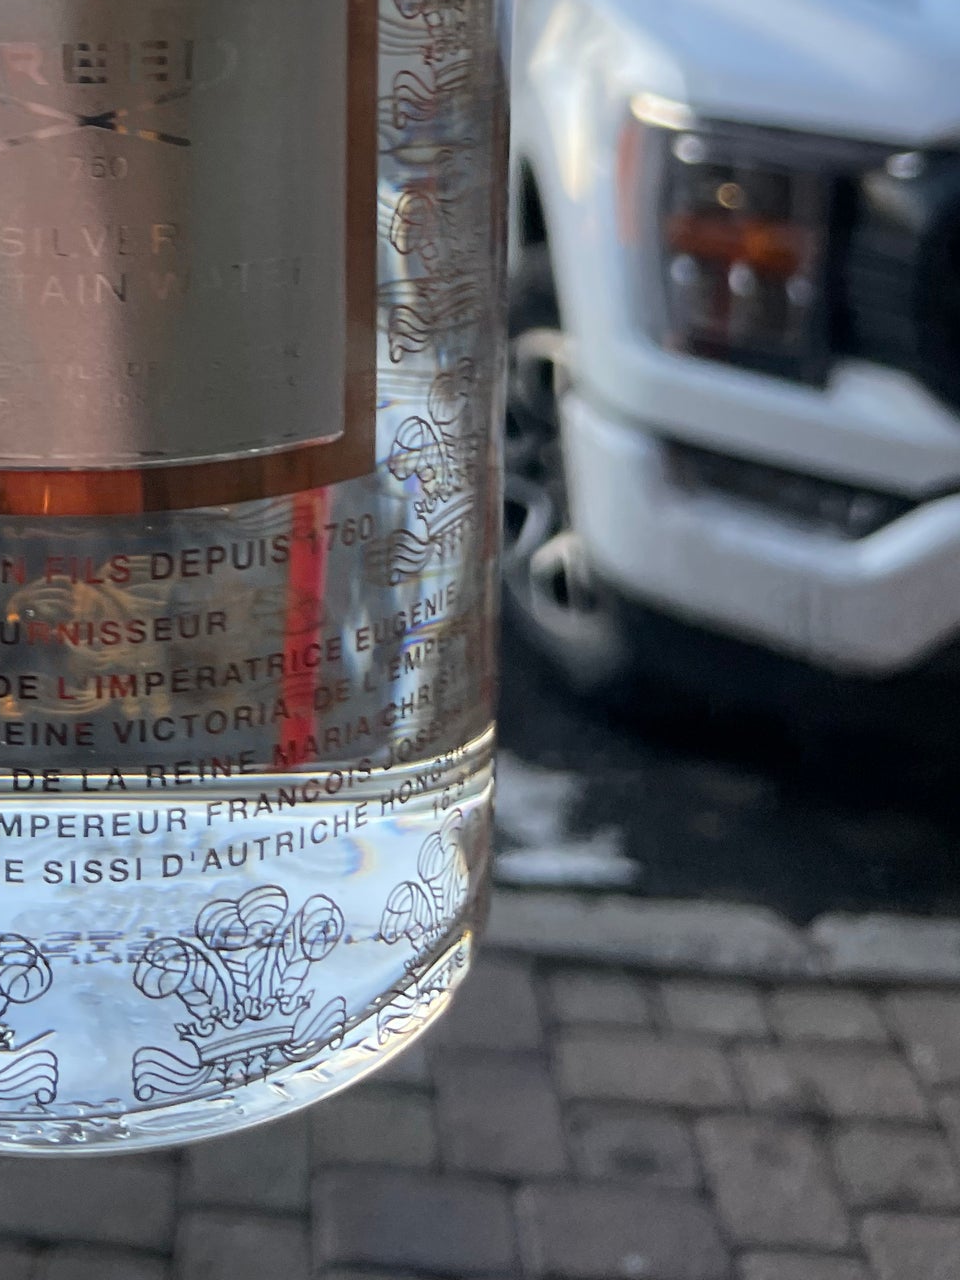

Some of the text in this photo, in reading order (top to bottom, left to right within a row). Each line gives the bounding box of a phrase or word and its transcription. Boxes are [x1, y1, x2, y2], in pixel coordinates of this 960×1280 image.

[0, 222, 178, 258] SILVER
[45, 553, 132, 585] FILS
[150, 533, 291, 581] DEPUIS
[308, 512, 376, 556] 1760
[355, 581, 458, 653] EUGENIE
[112, 696, 290, 745] VICTORIA
[314, 676, 352, 712] DE
[12, 767, 61, 793] DE
[81, 764, 127, 793] LA
[146, 749, 256, 789] REINE
[272, 717, 371, 766] MARIA
[206, 757, 372, 827] FRANCOIS
[43, 856, 142, 885] SISSI
[161, 801, 369, 879] D'AUTRICHE
